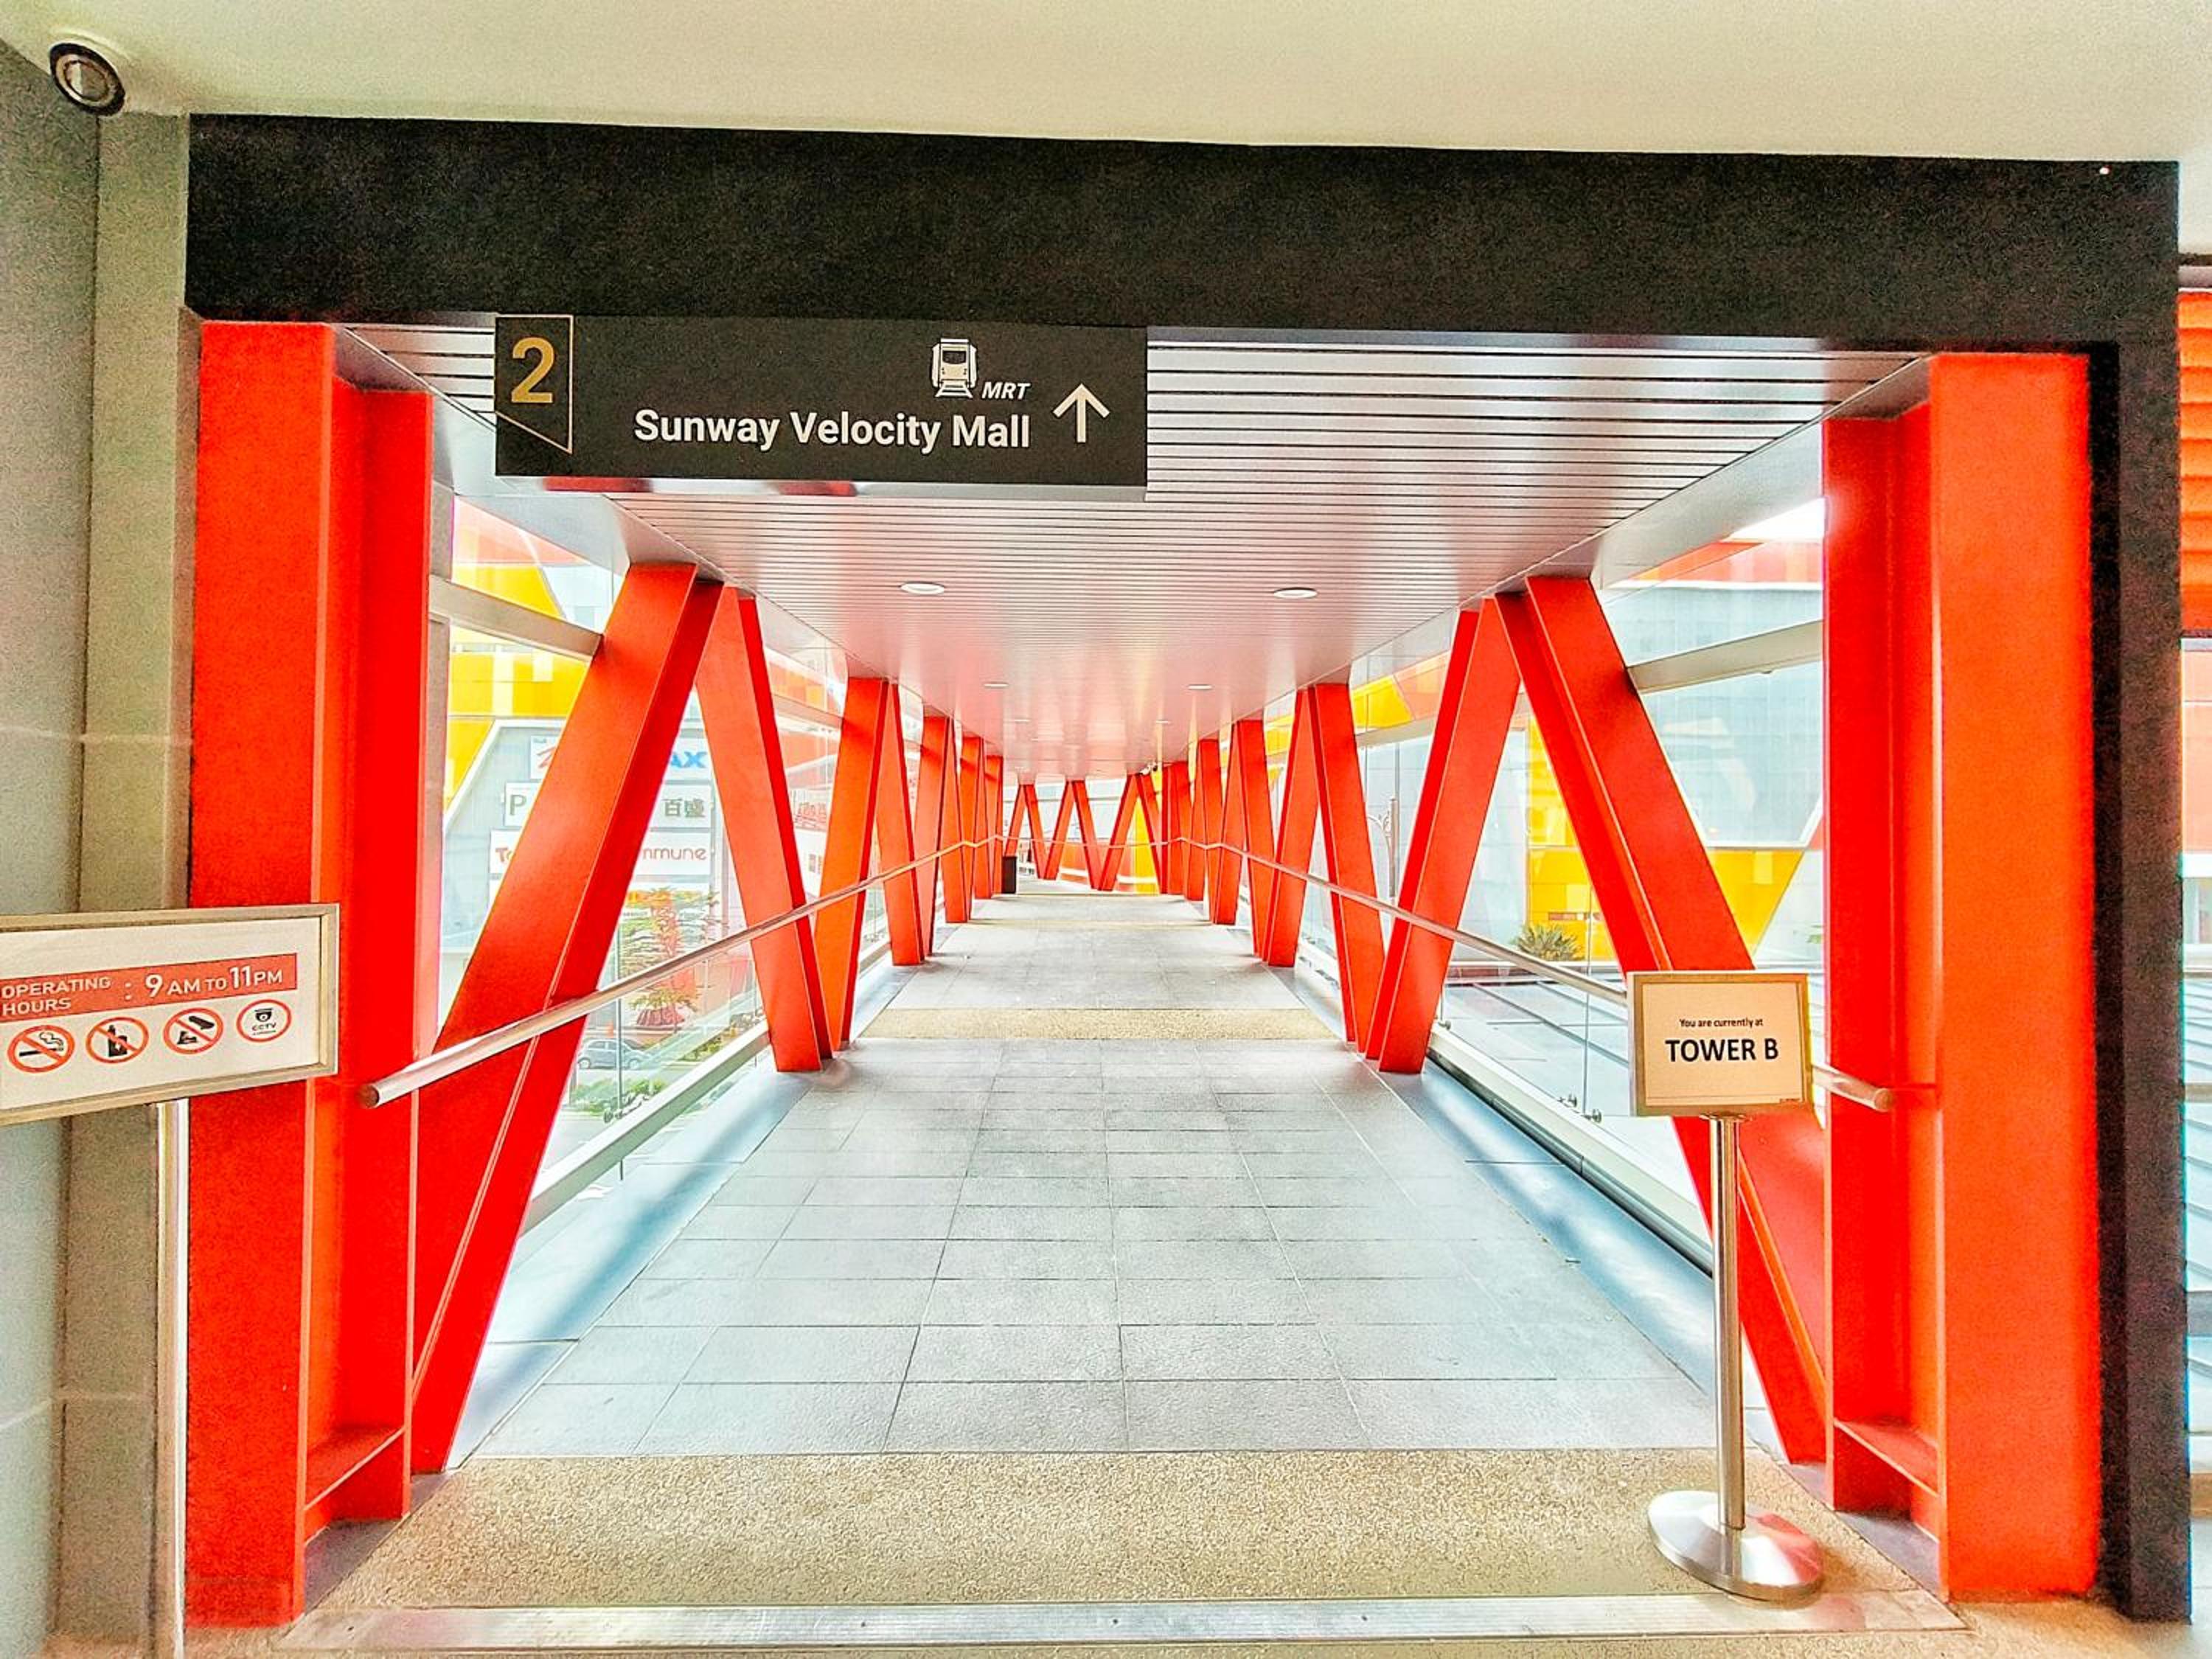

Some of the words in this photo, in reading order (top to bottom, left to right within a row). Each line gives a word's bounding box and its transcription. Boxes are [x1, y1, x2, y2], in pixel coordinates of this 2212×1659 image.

[511, 338, 554, 403] 2
[981, 381, 1031, 400] MRT
[634, 408, 780, 451] Sunway
[790, 411, 942, 455] Velocity
[952, 414, 1031, 448] Mall
[1, 976, 111, 999] OPERATING
[205, 978, 227, 991] TO
[2, 998, 72, 1015] HOURS
[251, 1022, 277, 1032] CCTV
[1679, 1018, 1696, 1027] You
[1714, 1018, 1754, 1029] currently
[1665, 1039, 1756, 1062] TOWER
[1764, 1037, 1778, 1060] B
